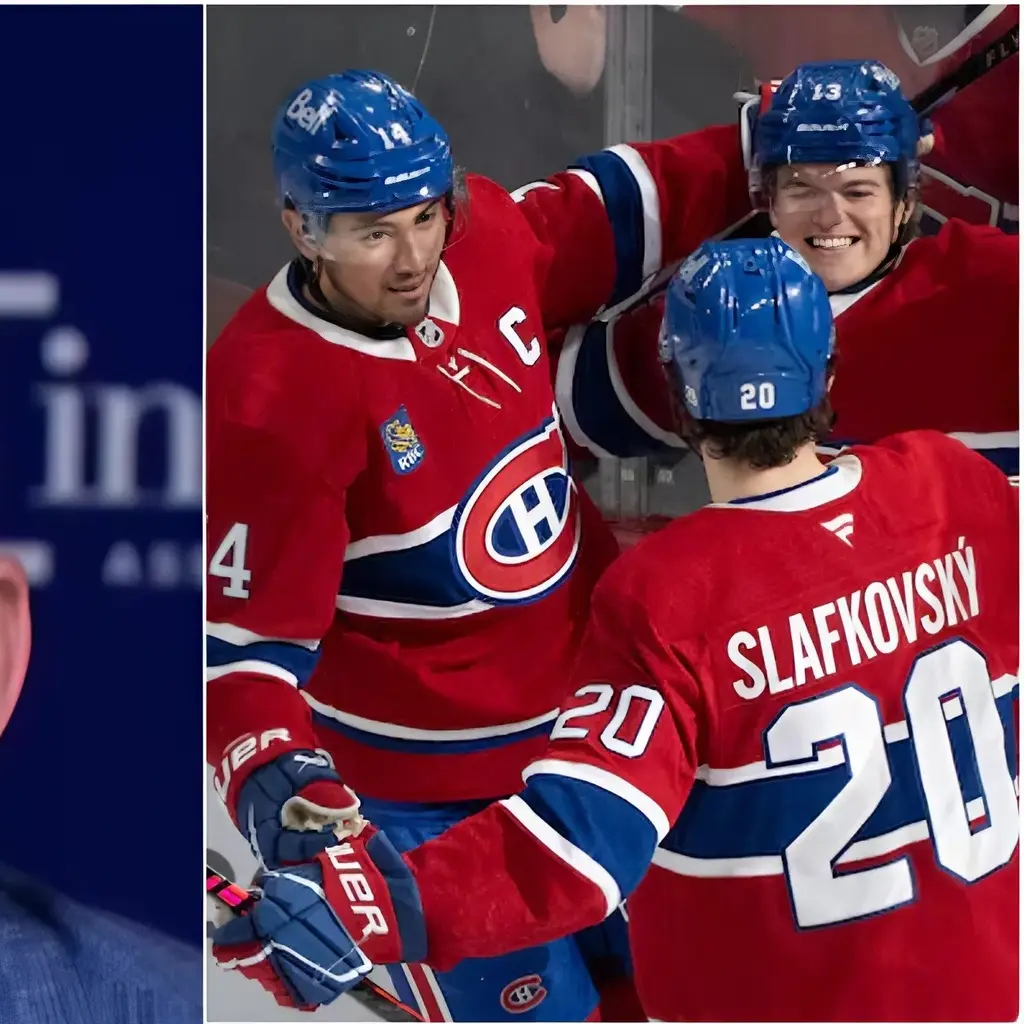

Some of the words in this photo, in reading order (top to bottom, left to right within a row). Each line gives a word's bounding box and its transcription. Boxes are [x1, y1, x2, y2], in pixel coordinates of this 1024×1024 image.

[497, 306, 542, 367] C
[740, 382, 775, 410] 20
[727, 536, 980, 700] SLAFKOVSKÝ
[550, 684, 665, 759] 20
[764, 637, 1020, 931] 20
